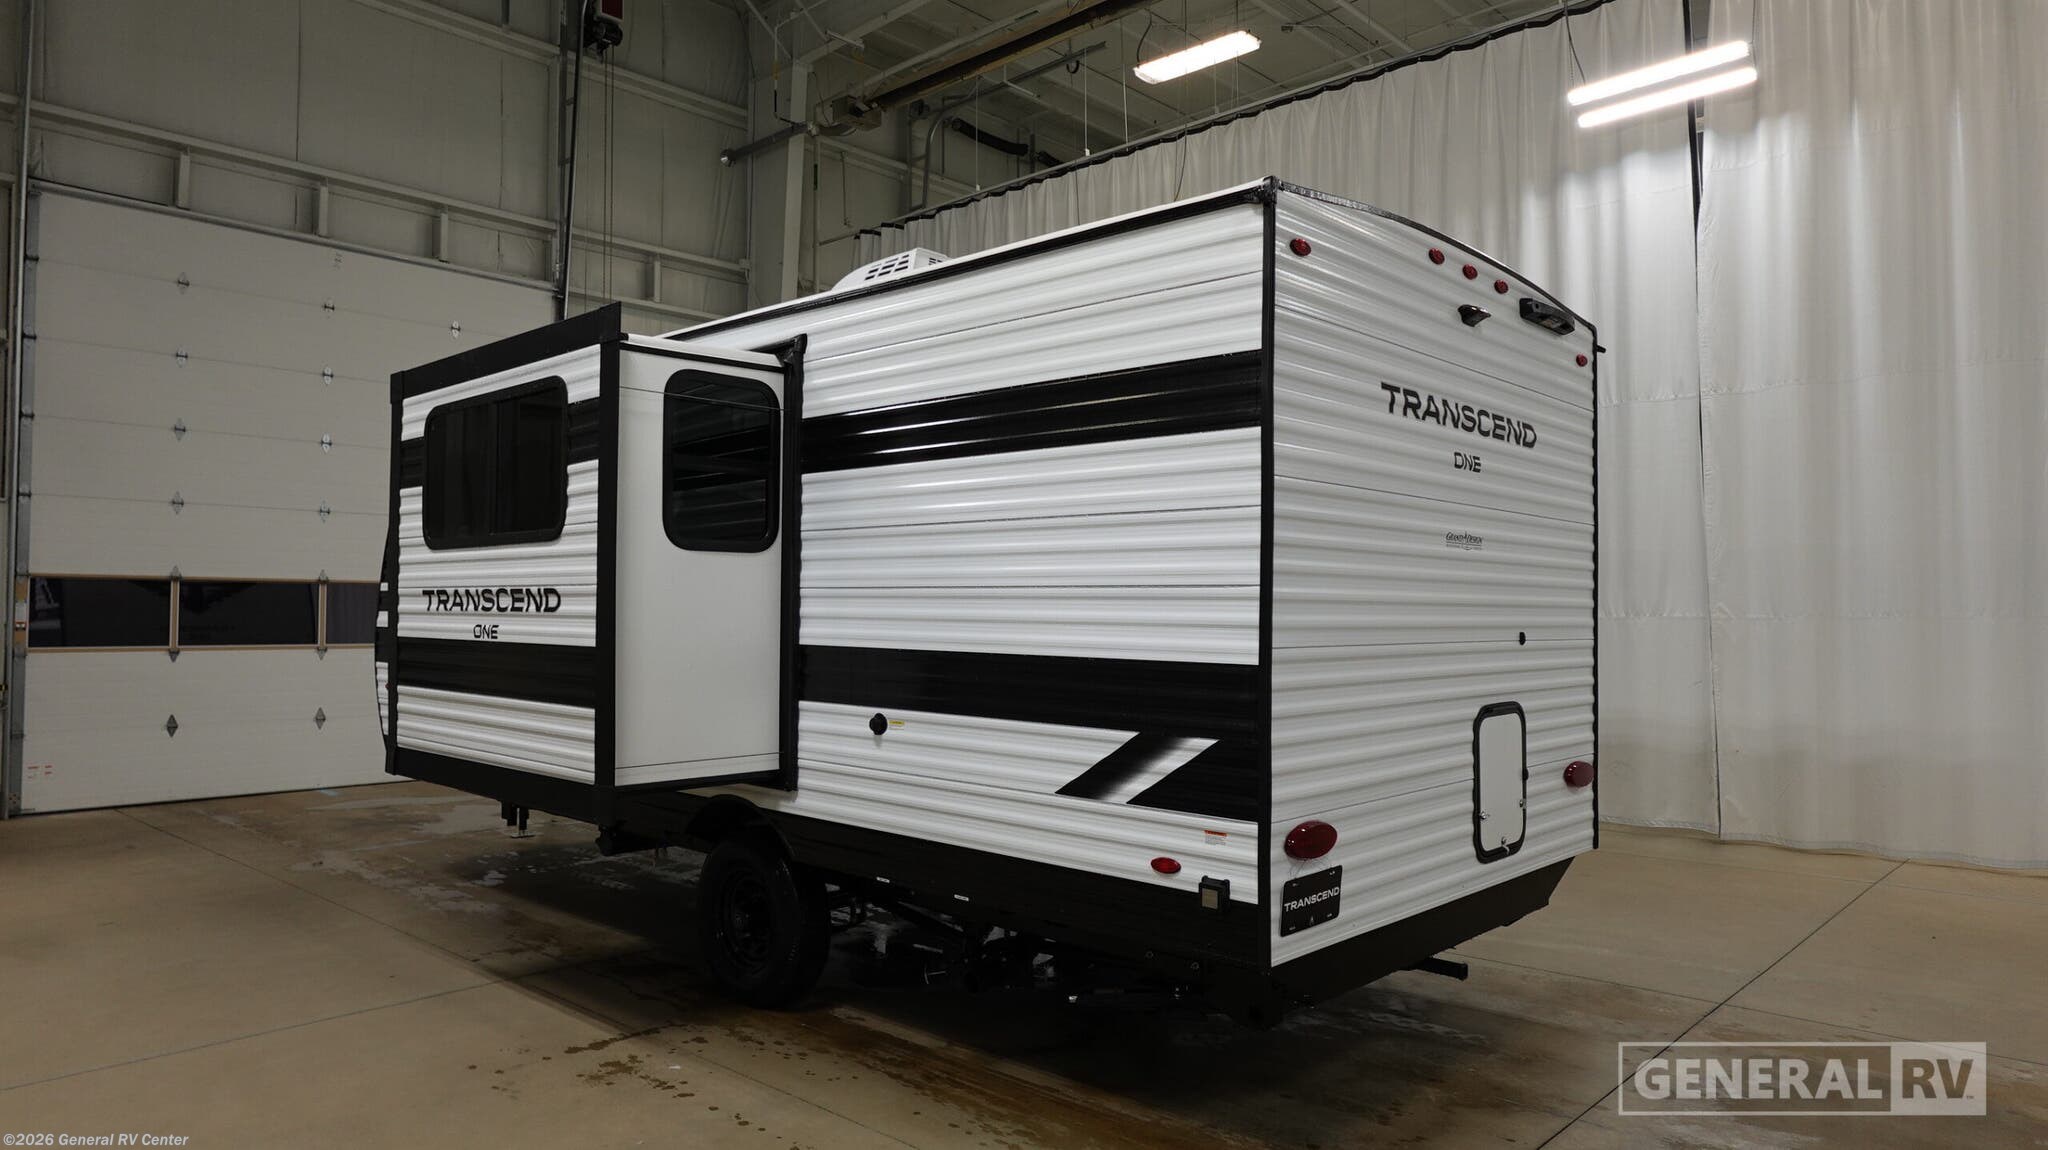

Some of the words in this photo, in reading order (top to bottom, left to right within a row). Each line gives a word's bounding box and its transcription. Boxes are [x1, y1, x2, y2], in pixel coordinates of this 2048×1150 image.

[1381, 382, 1537, 448] TRANSCEND
[422, 588, 561, 612] TRANSCEND
[473, 624, 499, 639] ONE
[1284, 887, 1340, 912] TRANSCEND
